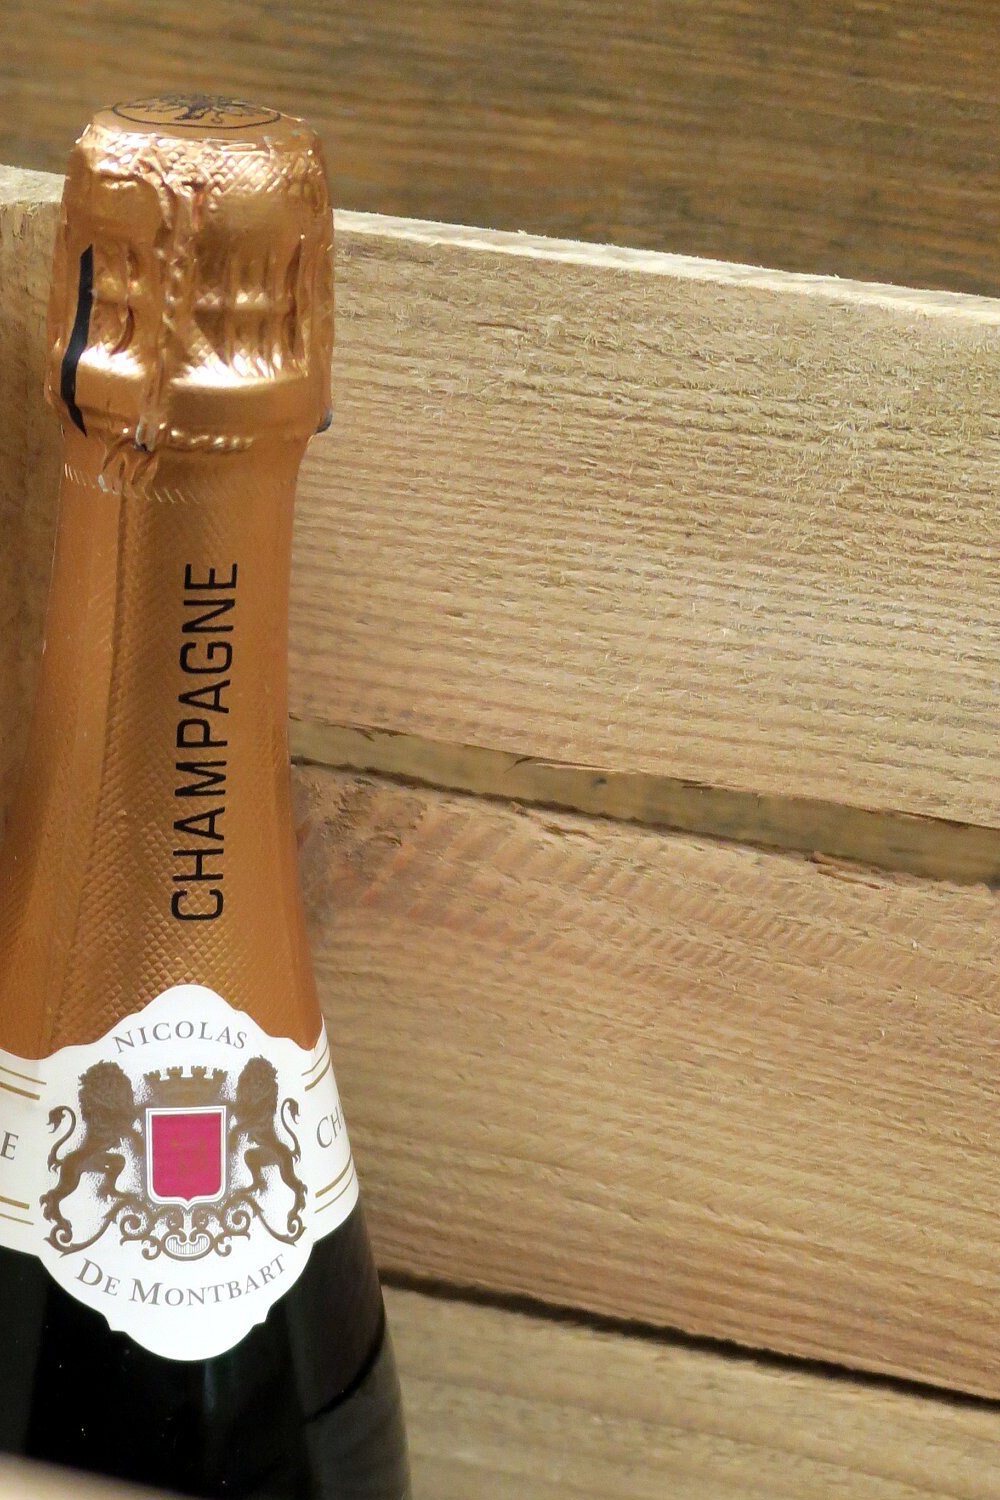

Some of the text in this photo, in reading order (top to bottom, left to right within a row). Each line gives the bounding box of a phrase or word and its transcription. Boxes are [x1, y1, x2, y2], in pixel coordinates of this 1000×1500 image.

[171, 563, 238, 921] CHAMPAGNE
[112, 1020, 247, 1053] NICOLAS
[75, 1253, 285, 1307] DE MONTBART
